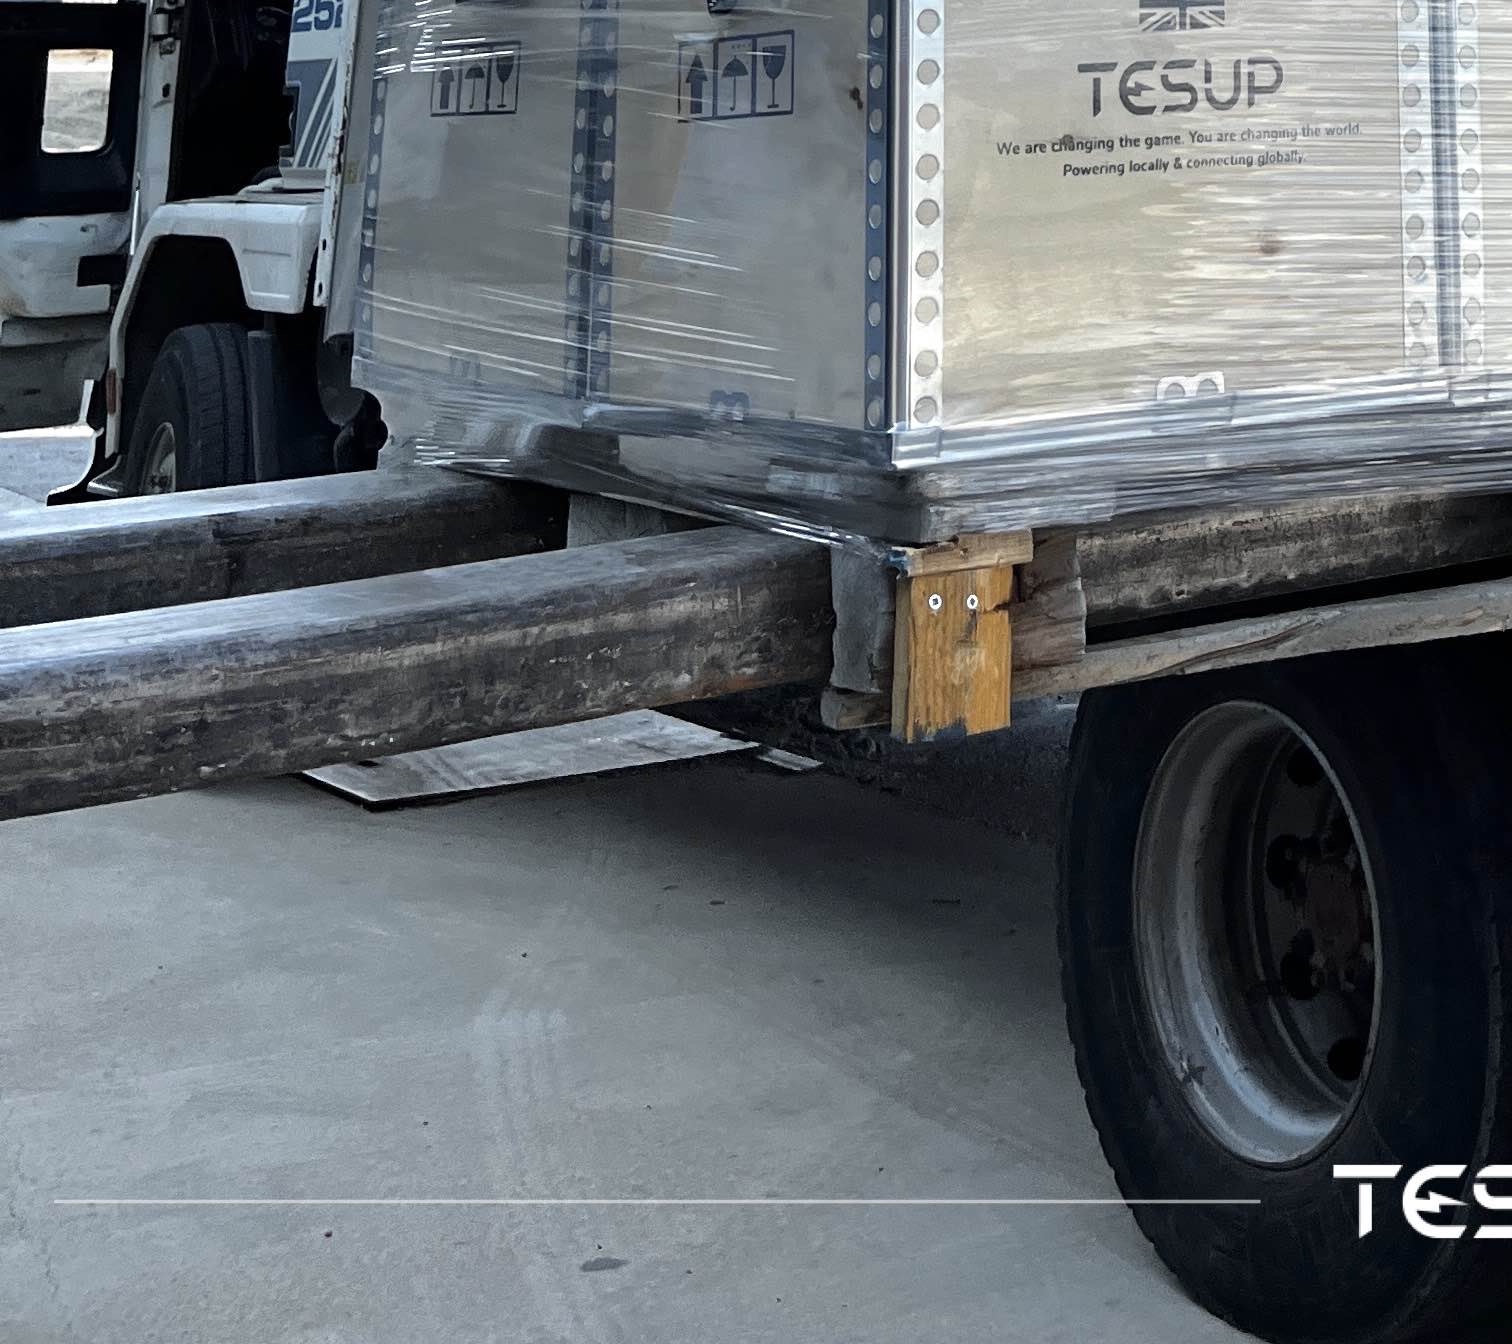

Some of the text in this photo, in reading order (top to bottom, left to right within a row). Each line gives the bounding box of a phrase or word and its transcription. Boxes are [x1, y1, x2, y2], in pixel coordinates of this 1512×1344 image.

[1077, 56, 1284, 117] TESUP
[997, 122, 1362, 155] We are changing the game. You are changing the world.
[1063, 149, 1306, 177] Powering locally & connecting globally.
